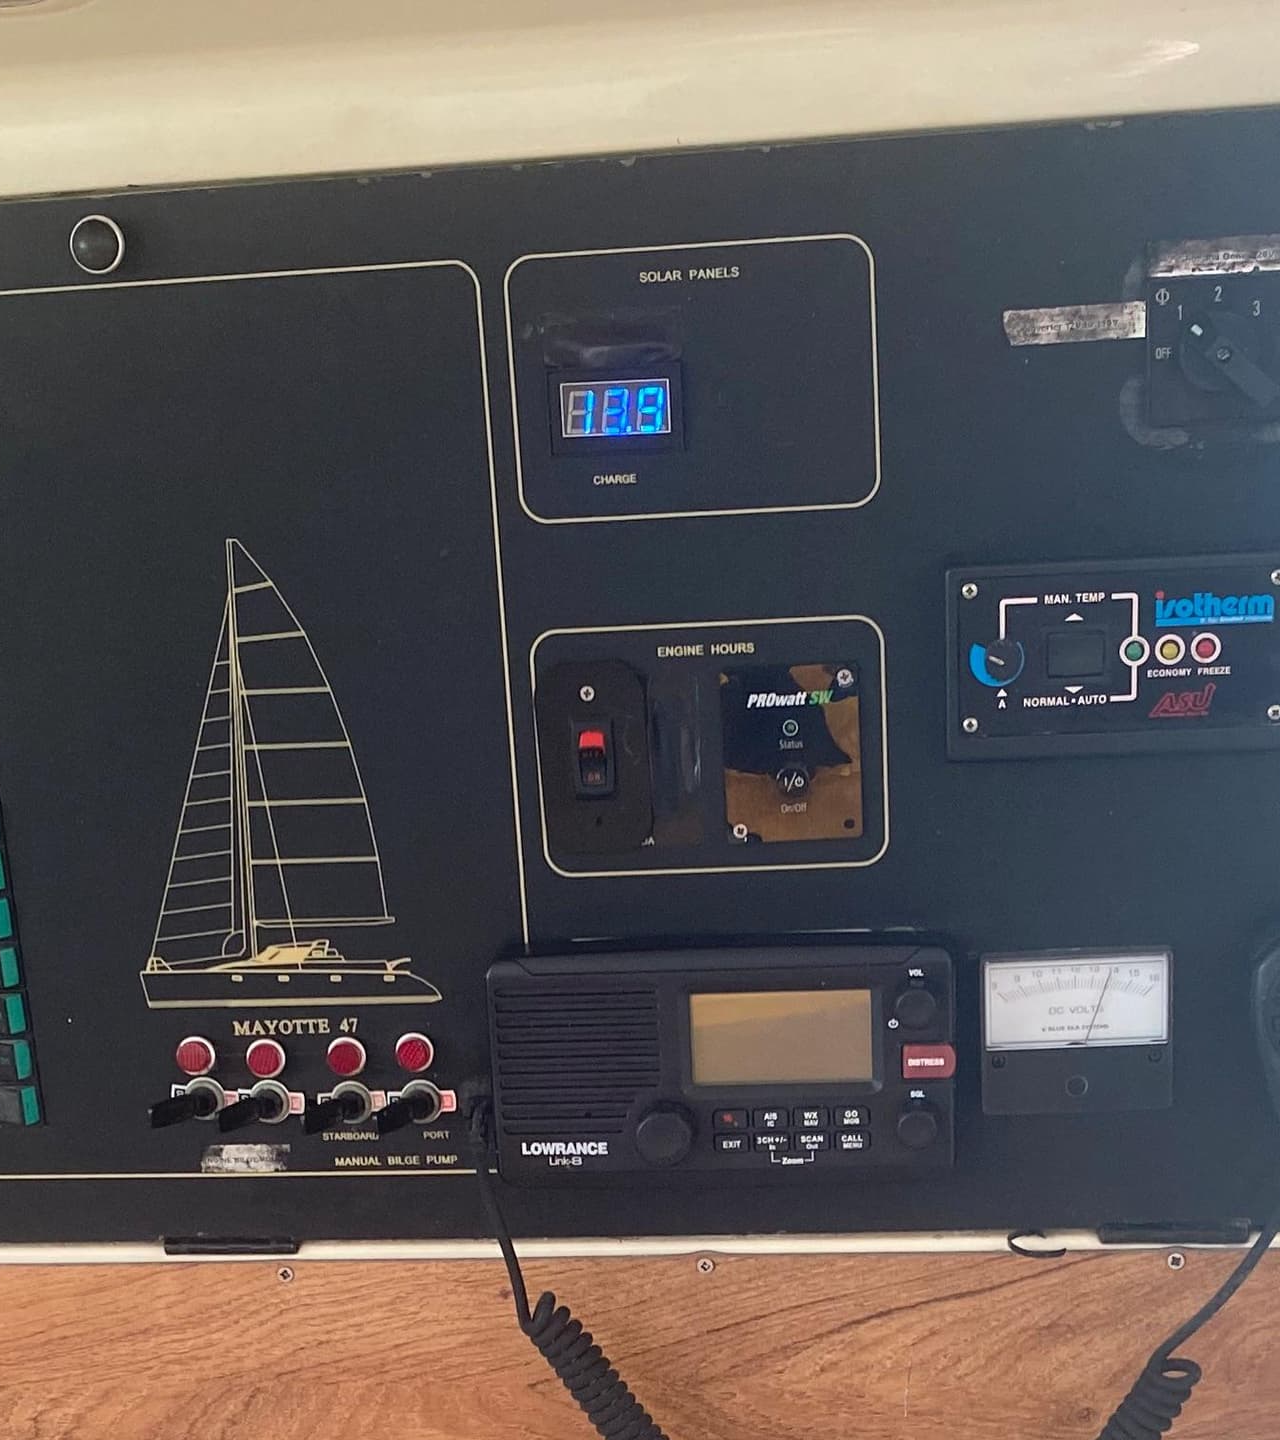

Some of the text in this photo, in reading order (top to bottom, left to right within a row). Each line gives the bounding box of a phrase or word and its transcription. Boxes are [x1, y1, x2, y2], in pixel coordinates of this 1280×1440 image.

[639, 267, 740, 283] SOLAR PANELS
[1215, 287, 1222, 302] 2
[1178, 305, 1183, 321] 1
[1253, 301, 1260, 317] 3
[1156, 348, 1171, 359] OFF
[582, 386, 665, 434] 13.9
[593, 474, 637, 486] CHARGE
[1044, 592, 1106, 605] MAN. TEMP
[1155, 589, 1275, 619] isotherm
[657, 643, 755, 658] ENGINE HOURS
[1147, 665, 1231, 679] ECONOMY FREEZE
[747, 689, 833, 709] PROwatt SW
[999, 699, 1007, 709] A
[1023, 695, 1107, 708] NORMAL AUTO
[779, 739, 804, 750] Status
[781, 802, 807, 814] On/Off
[1048, 1006, 1065, 1016] DC
[233, 1018, 358, 1036] MAYOTTE 47
[908, 1057, 945, 1067] DISTRESS
[804, 1111, 818, 1120] WX
[423, 1130, 450, 1141] PORT
[800, 1135, 824, 1144] SCAN
[841, 1134, 863, 1143] CALL
[522, 1142, 608, 1156] LOWRANCE
[722, 1140, 741, 1149] EXIT
[335, 1154, 458, 1167] MANUAL BILGE PUMP
[549, 1156, 583, 1167] Link-8
[782, 1156, 804, 1165] Zoom
